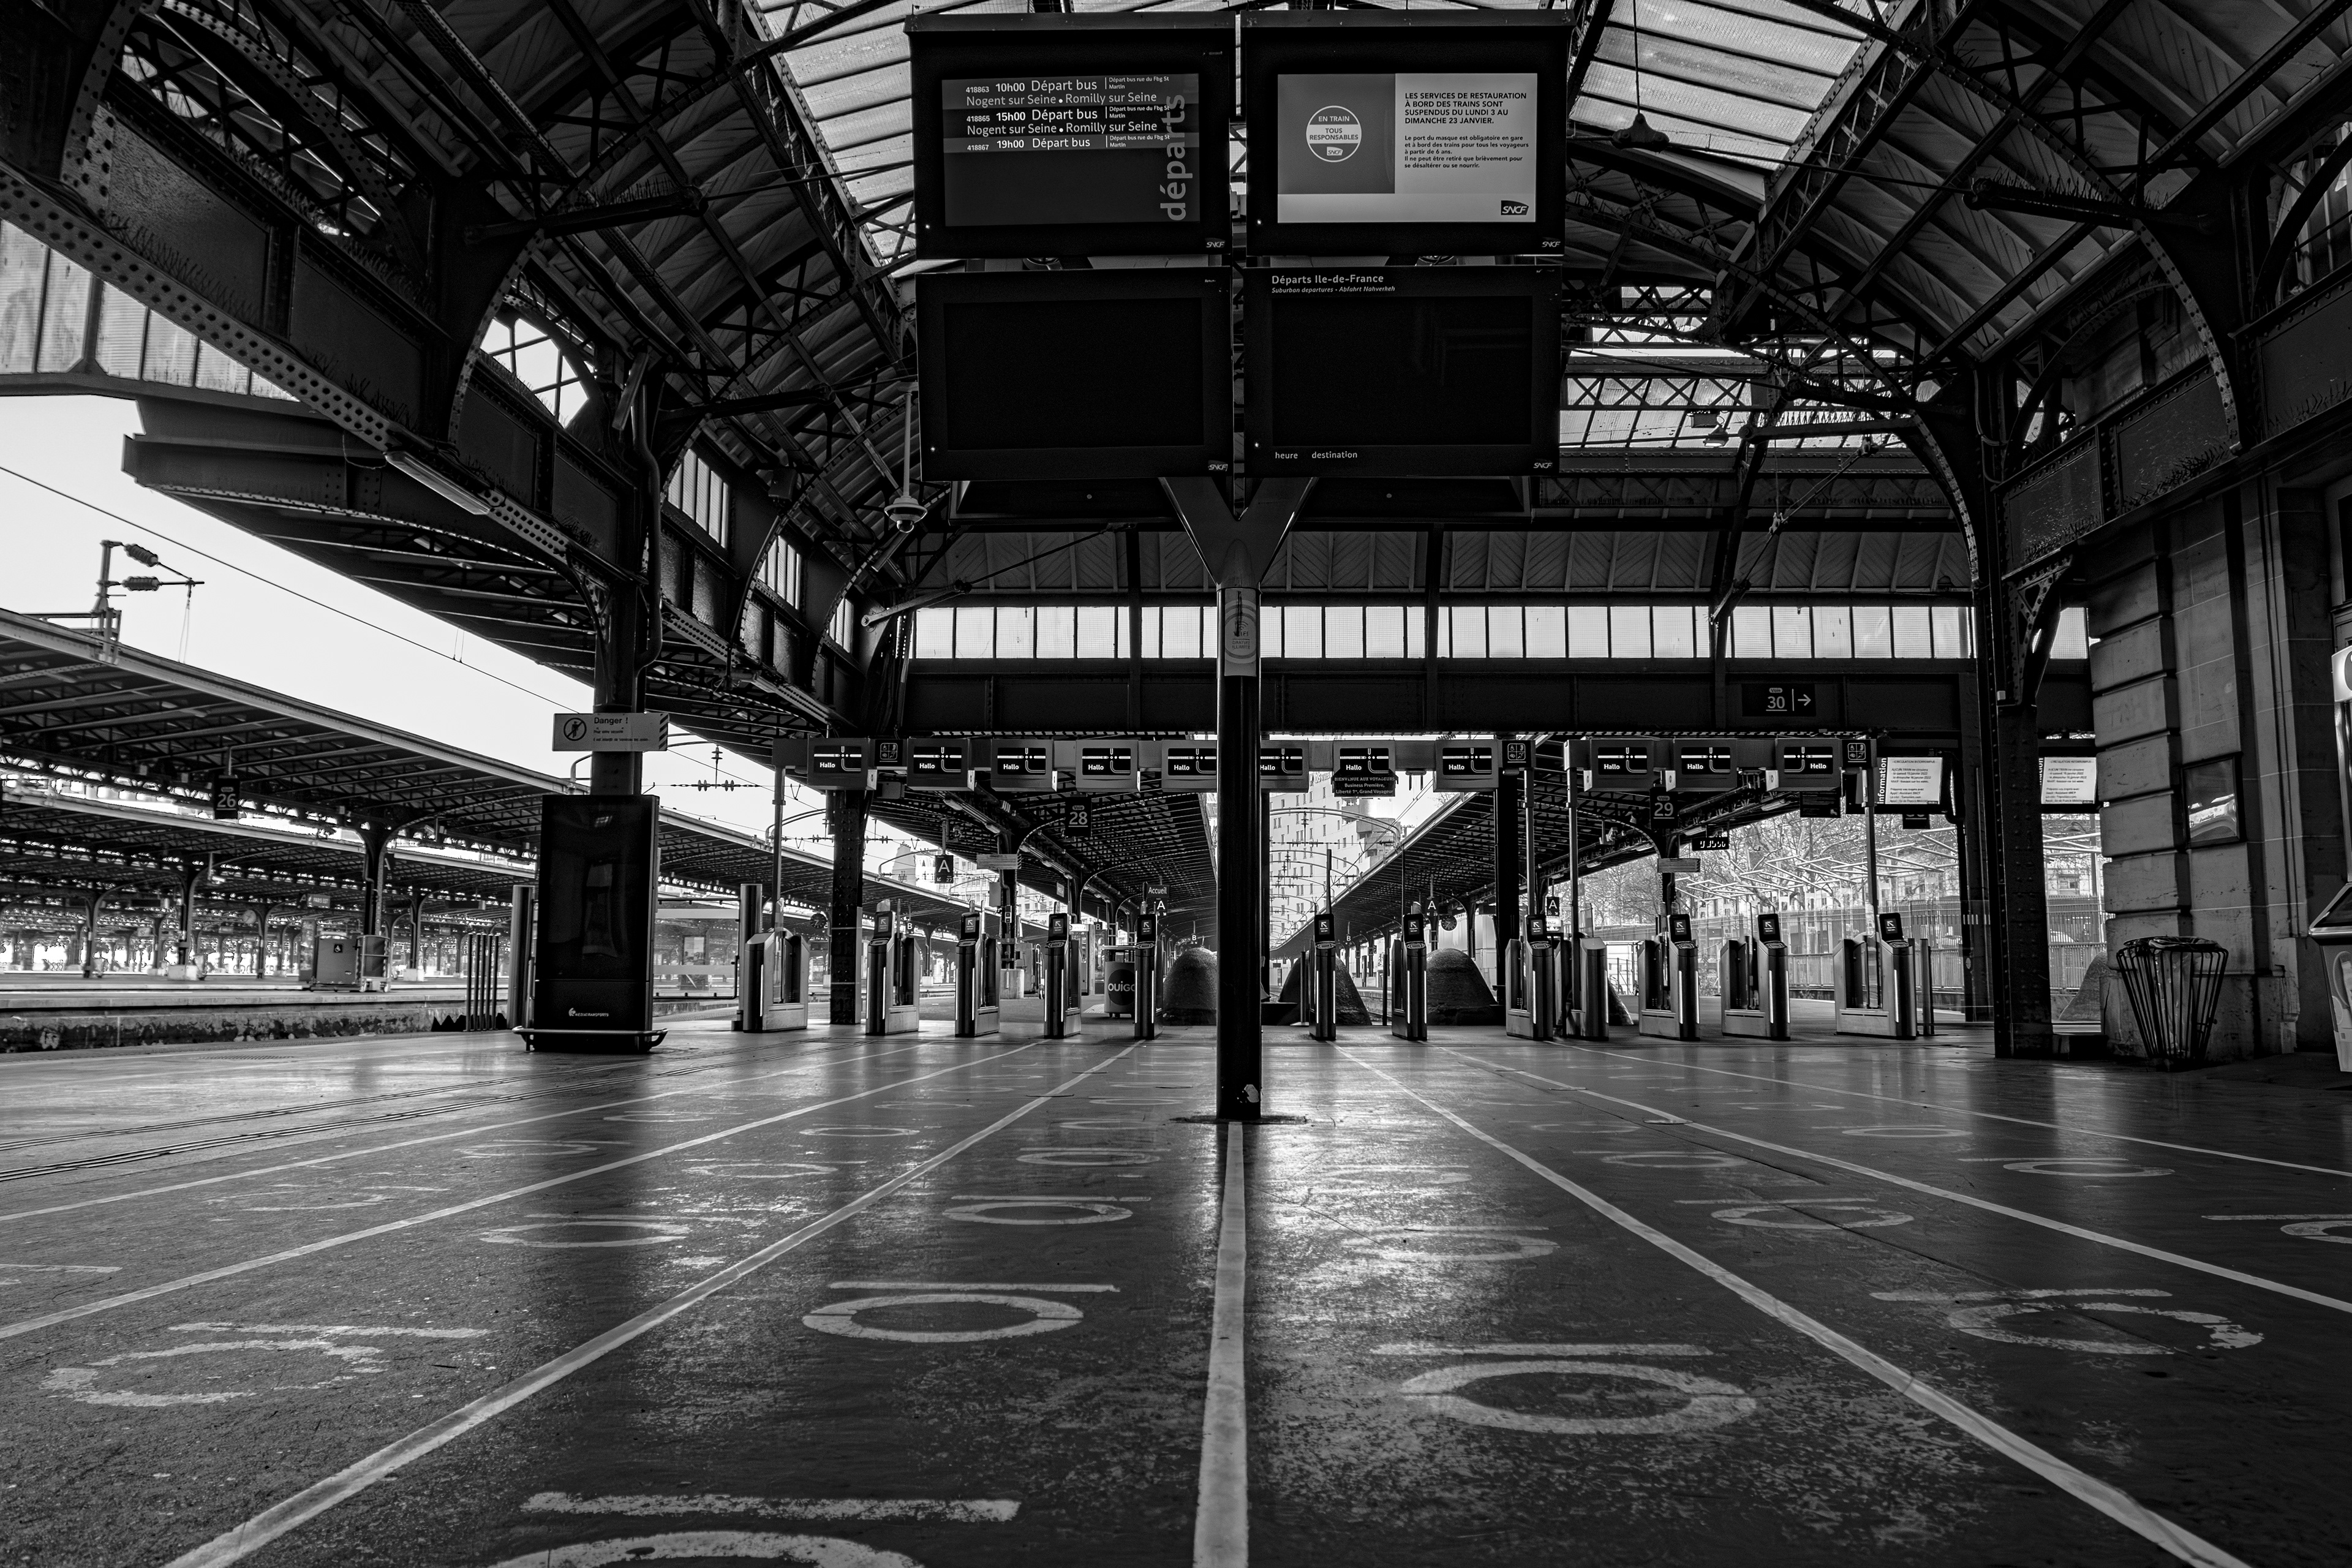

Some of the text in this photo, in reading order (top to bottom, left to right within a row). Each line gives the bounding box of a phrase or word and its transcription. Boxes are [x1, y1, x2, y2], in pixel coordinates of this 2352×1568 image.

[995, 83, 1025, 92] 10h00
[1031, 80, 1072, 94] Départ
[1076, 79, 1098, 90] bus
[967, 92, 1157, 108] Nogent sur Seine Romilly sur Seine
[996, 111, 1026, 121] 15h00
[1031, 109, 1073, 123] Départ
[1077, 108, 1098, 119] bus
[967, 121, 1157, 137] Nogent sur Seine Romilly sur Seine
[997, 140, 1024, 149] 19h00
[1032, 138, 1069, 150] Départ
[1072, 137, 1090, 147] bus
[1160, 94, 1193, 221] départs
[1502, 205, 1528, 215] SNCF
[1272, 274, 1384, 286] Départs Ile-de-France
[1767, 696, 1785, 709] 30
[594, 717, 623, 725] Danger
[1877, 758, 1887, 804] information
[217, 793, 236, 807] 26
[1654, 802, 1674, 816] 29
[1069, 812, 1088, 825] 28
[938, 859, 950, 873] A
[1156, 900, 1166, 910] A
[1427, 900, 1436, 910] A
[1548, 900, 1558, 909] A
